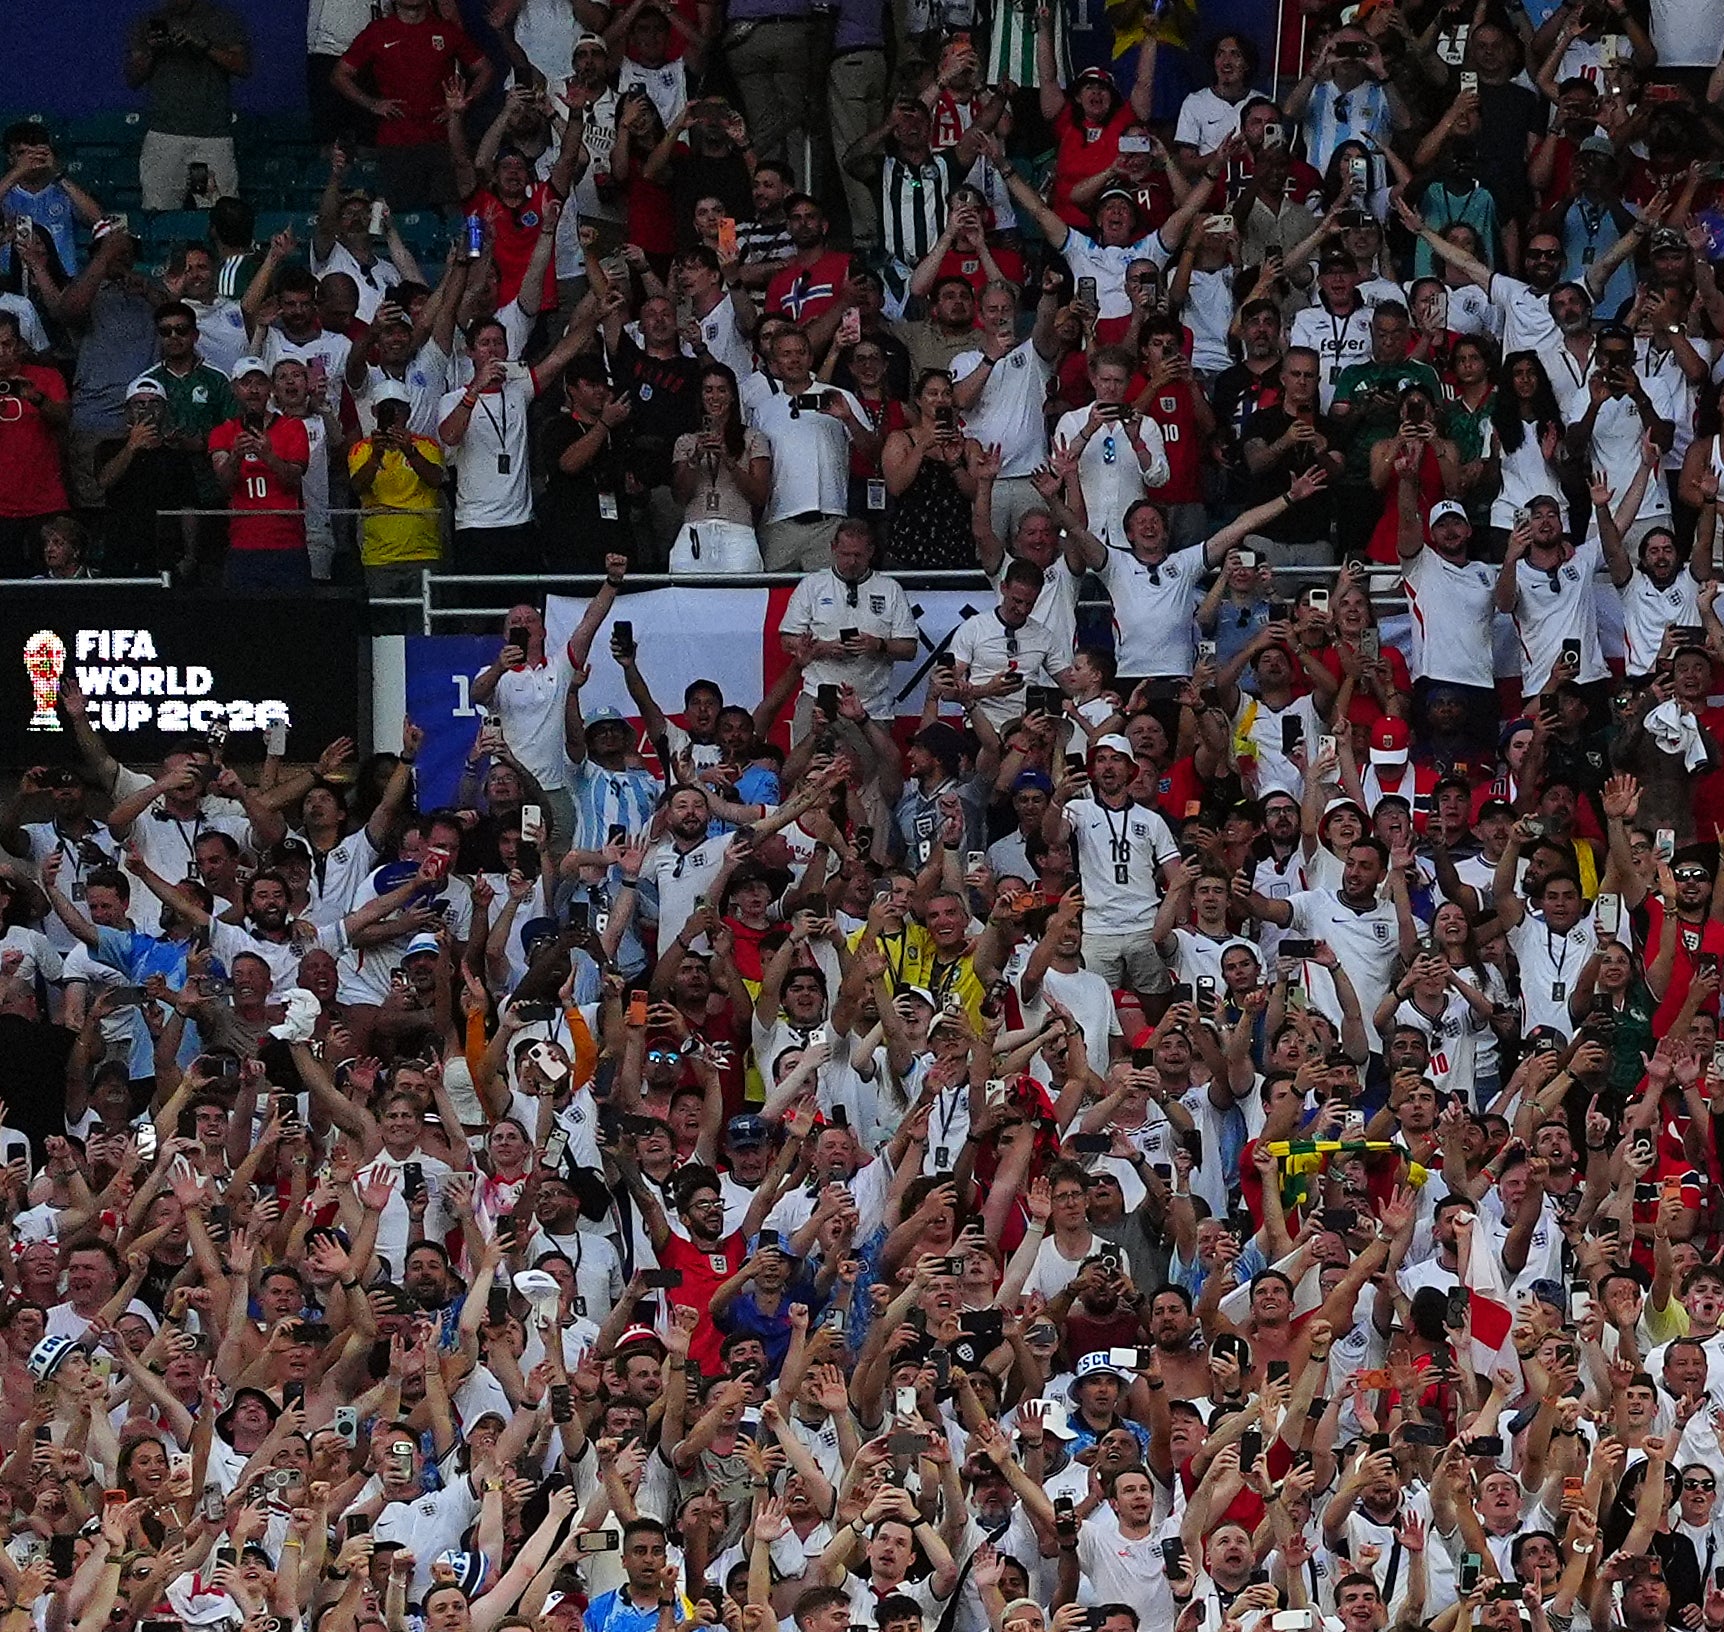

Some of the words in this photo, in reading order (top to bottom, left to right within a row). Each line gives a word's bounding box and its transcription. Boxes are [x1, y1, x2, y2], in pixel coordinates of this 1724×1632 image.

[246, 477, 267, 499] 10
[76, 629, 157, 661] FIFA
[76, 666, 213, 696] WORLD
[1109, 839, 1130, 863] 18
[1430, 1051, 1450, 1077] 10
